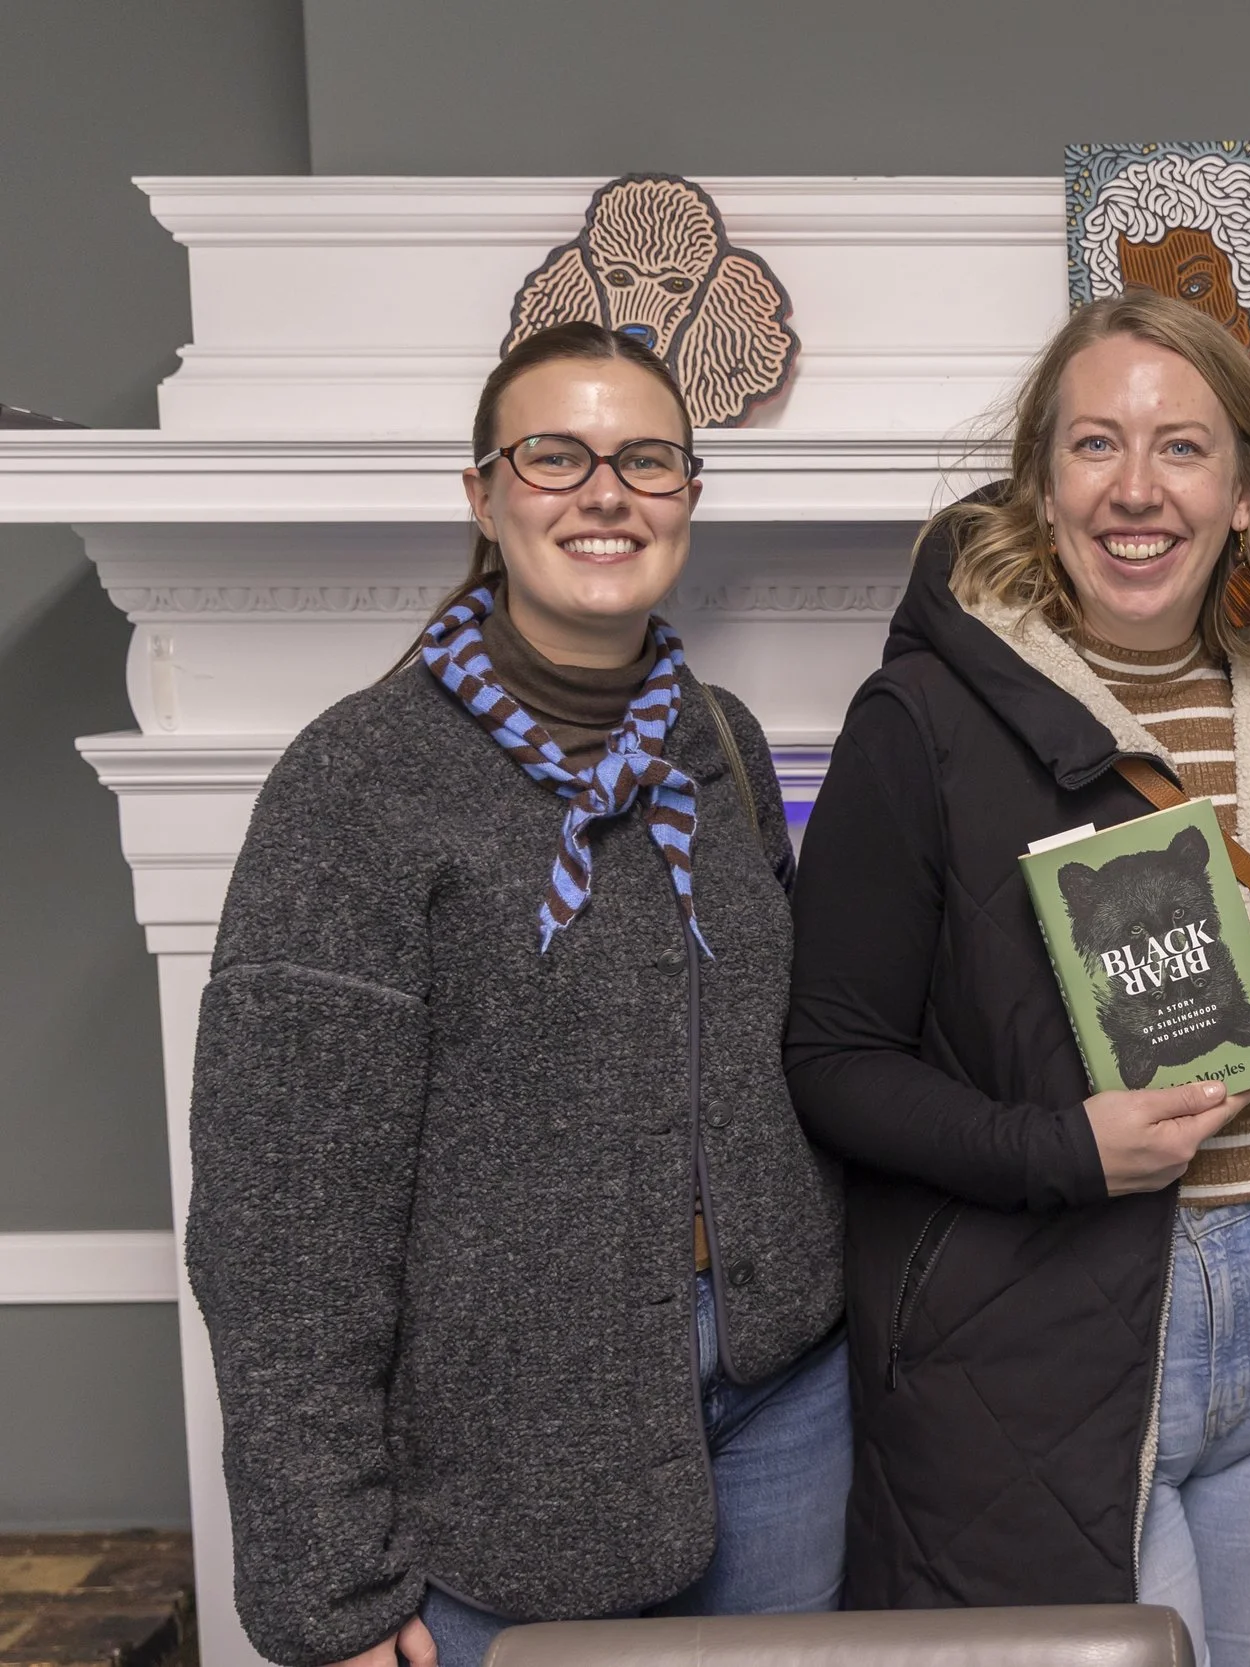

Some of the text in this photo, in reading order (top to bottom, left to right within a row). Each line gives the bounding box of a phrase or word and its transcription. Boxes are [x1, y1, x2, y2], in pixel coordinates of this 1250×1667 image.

[1100, 918, 1215, 978] BLACK
[1119, 946, 1211, 996] BEAR
[1142, 1004, 1217, 1034] OF SIBLINGHOOD
[1166, 998, 1195, 1013] STORY
[1151, 1018, 1217, 1045] AND SURVIVAL
[1195, 1062, 1246, 1083] Moyles
